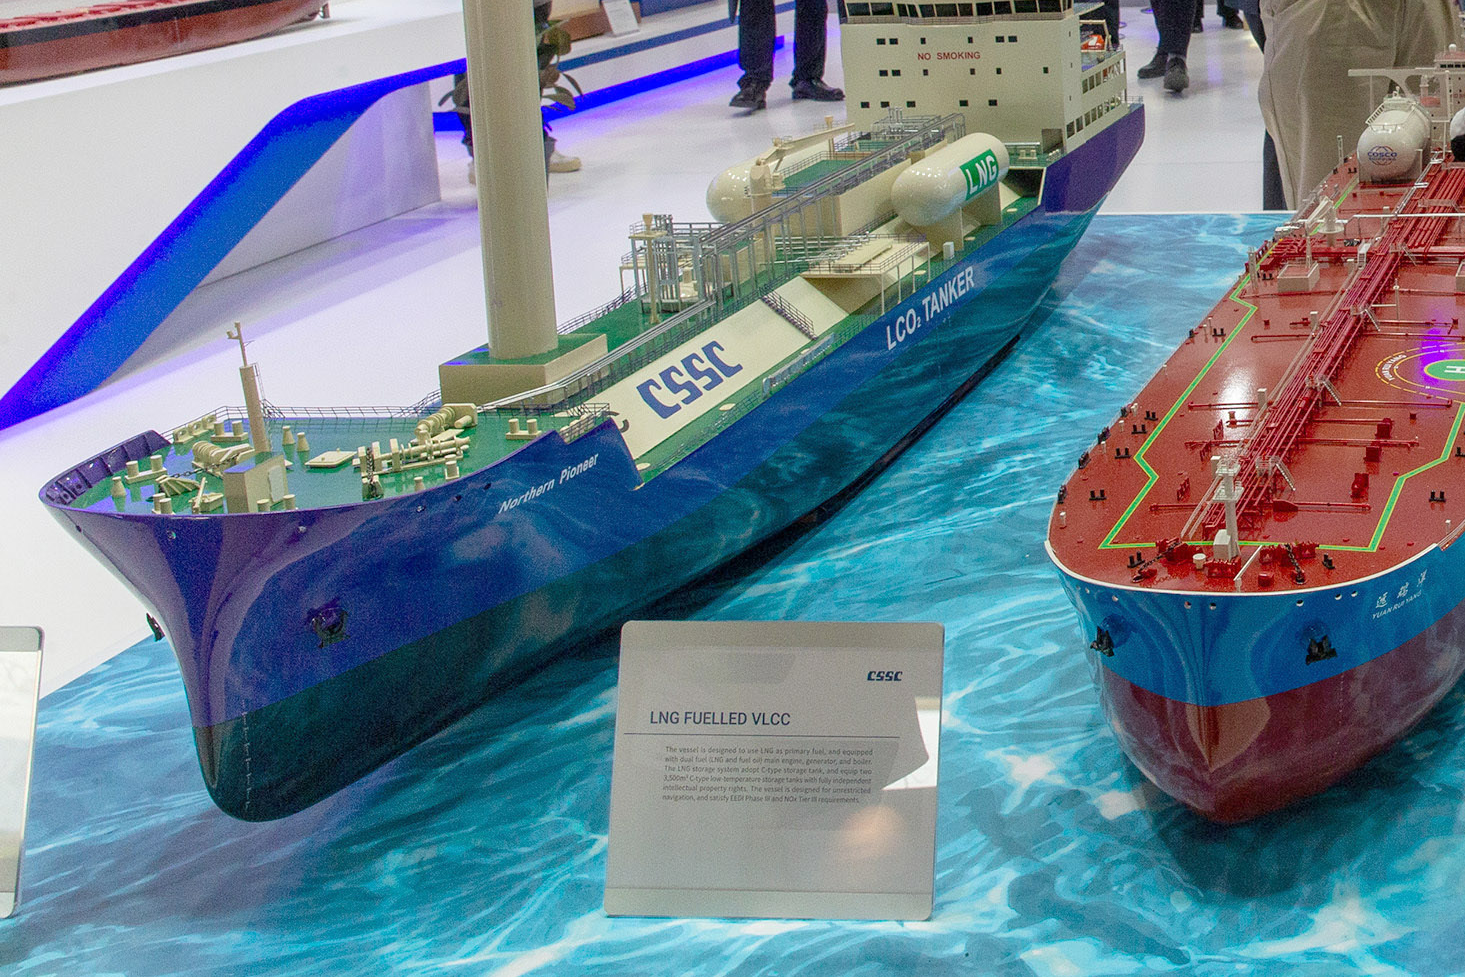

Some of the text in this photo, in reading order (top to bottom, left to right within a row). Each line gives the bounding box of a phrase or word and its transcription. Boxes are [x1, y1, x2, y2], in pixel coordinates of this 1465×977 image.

[917, 51, 982, 61] NO SMOKING
[964, 155, 999, 195] LNG
[922, 266, 976, 325] TANKER
[636, 340, 743, 419] CSSC
[497, 452, 599, 515] Northern Pioneer
[867, 671, 903, 681] CSSC
[650, 711, 791, 726] LNG FUELLED VLCC
